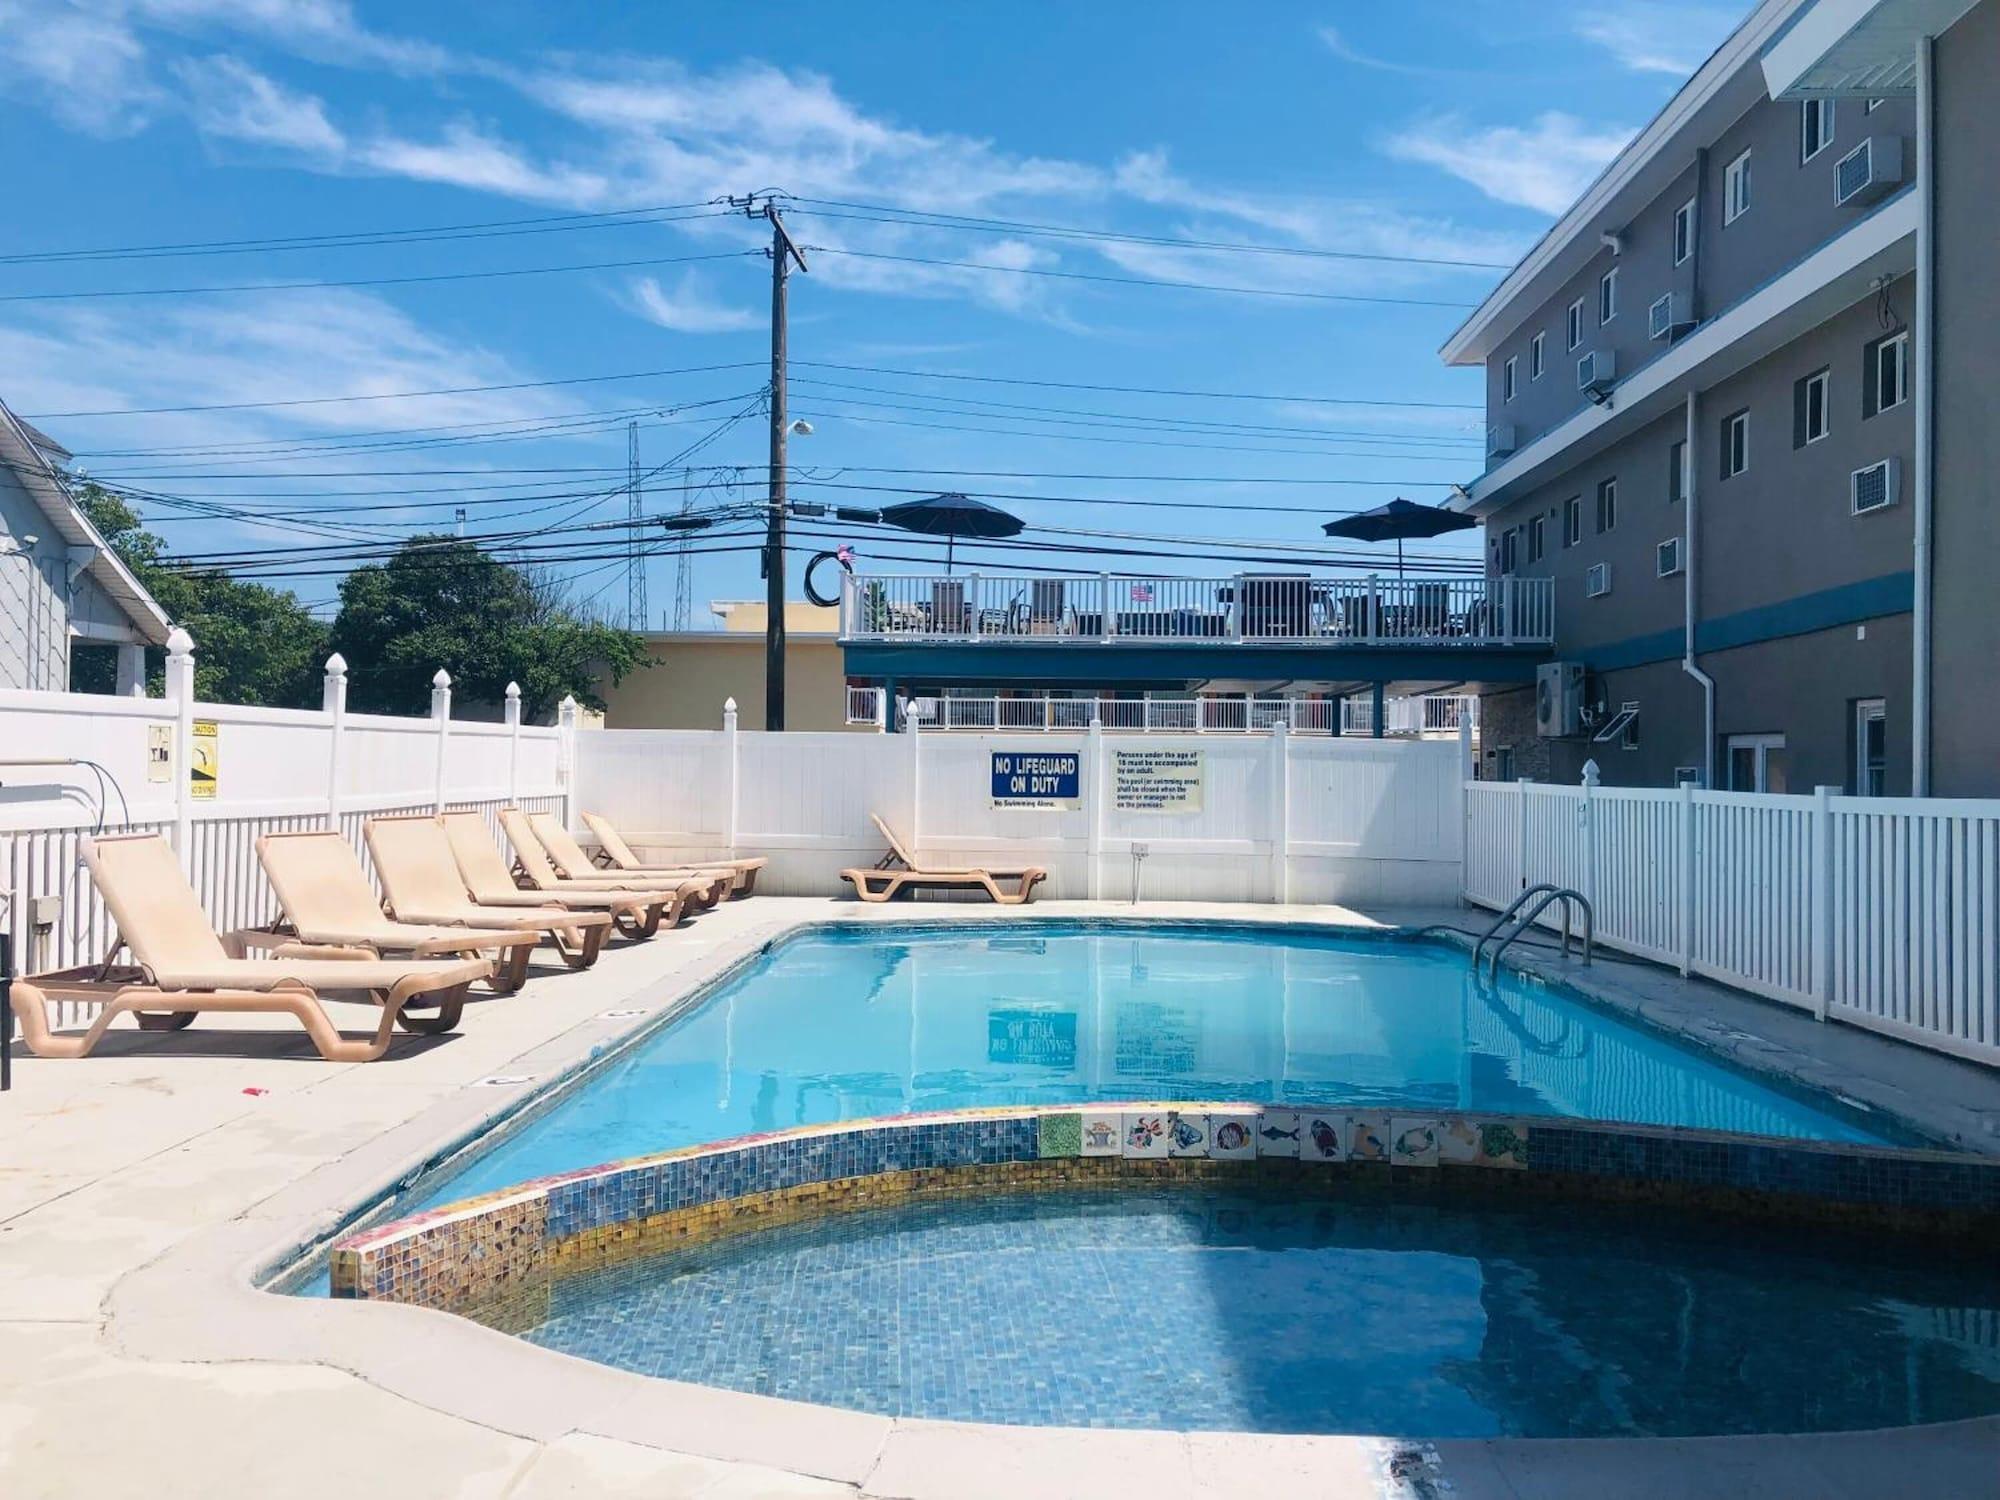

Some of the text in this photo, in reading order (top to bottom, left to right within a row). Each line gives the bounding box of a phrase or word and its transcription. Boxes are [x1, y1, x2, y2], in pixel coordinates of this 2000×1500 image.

[996, 758, 1075, 774] NO LIFEGUARD
[1011, 776, 1059, 793] ON DUTY
[1004, 800, 1035, 808] Swimming
